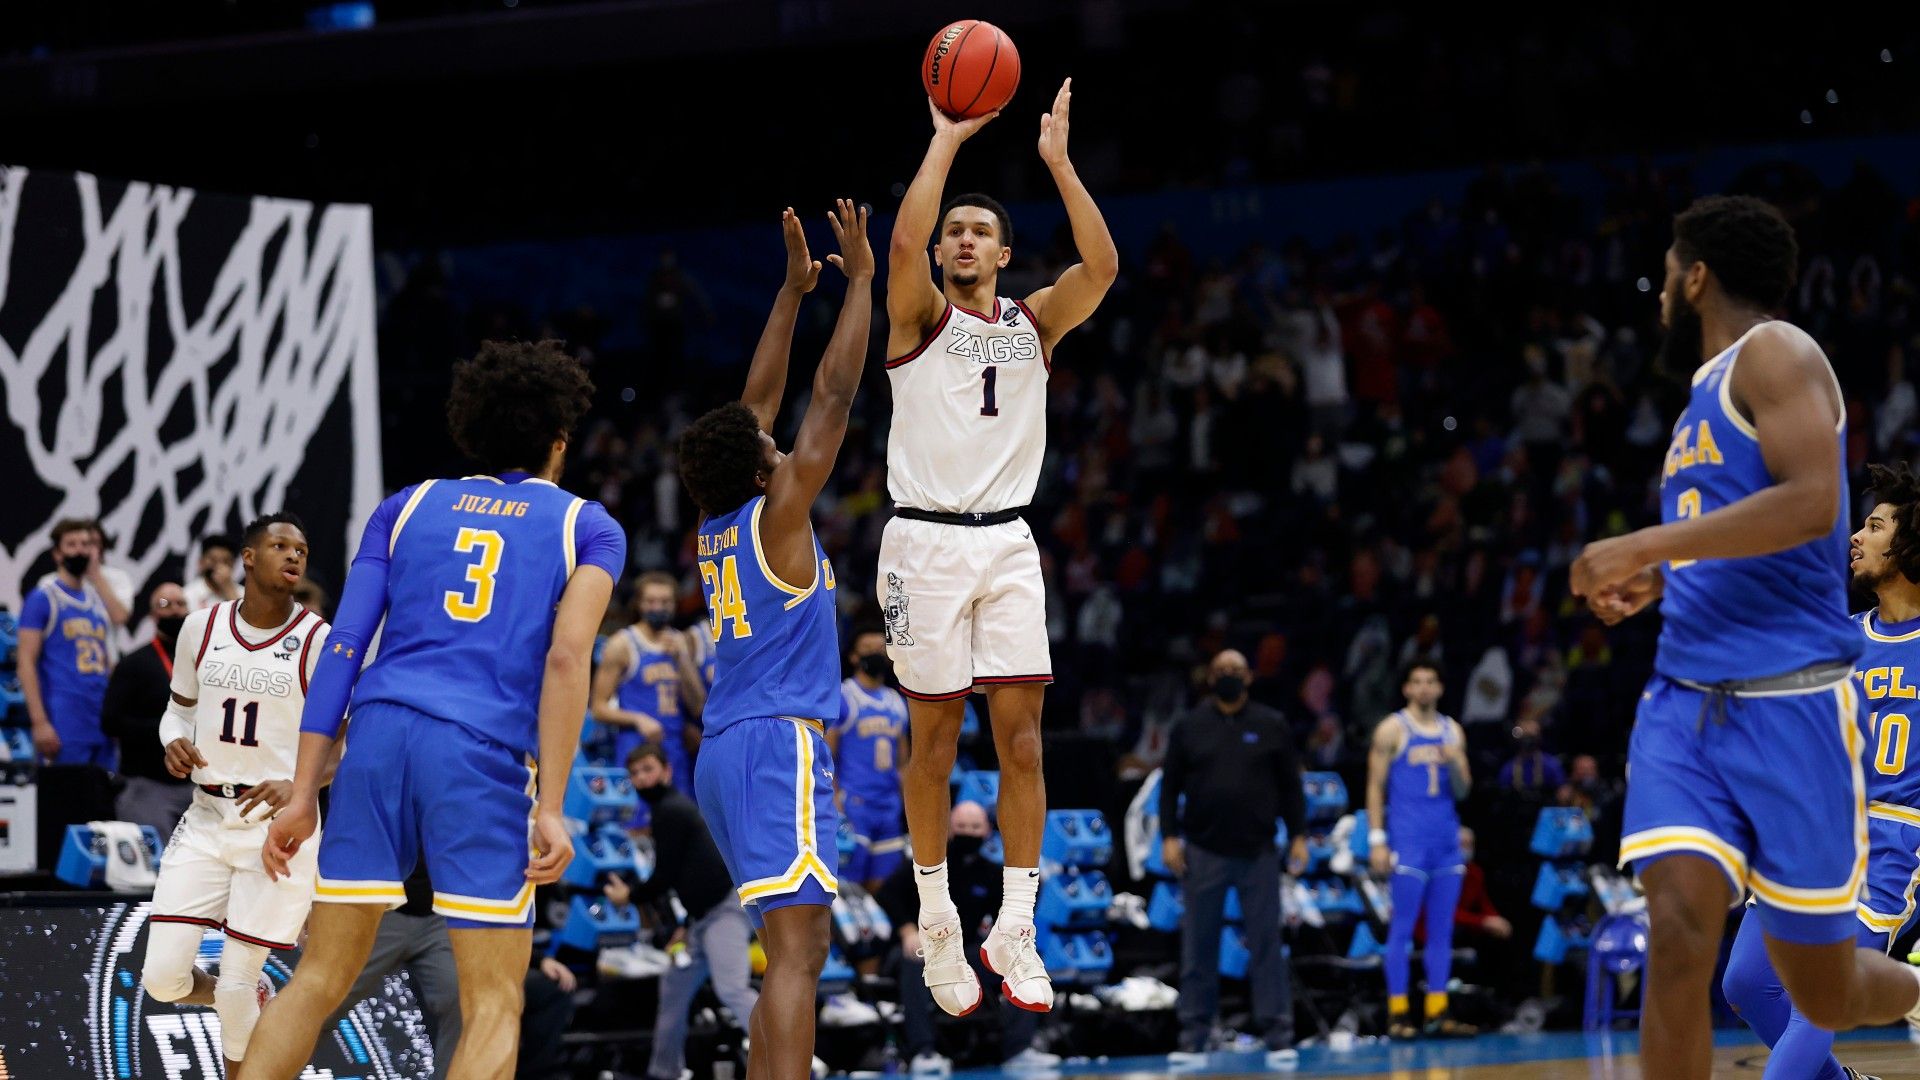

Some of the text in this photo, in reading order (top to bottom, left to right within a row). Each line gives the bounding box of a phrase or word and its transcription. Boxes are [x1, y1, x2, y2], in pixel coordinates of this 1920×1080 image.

[947, 326, 1037, 363] ZAGS
[980, 366, 998, 416] 1
[1660, 419, 1724, 488] CLA
[452, 493, 530, 517] JUZANG
[443, 526, 505, 623] 3
[699, 555, 752, 642] 34
[204, 661, 293, 697] ZAGS
[1855, 666, 1920, 700] CL
[220, 697, 259, 747] 11
